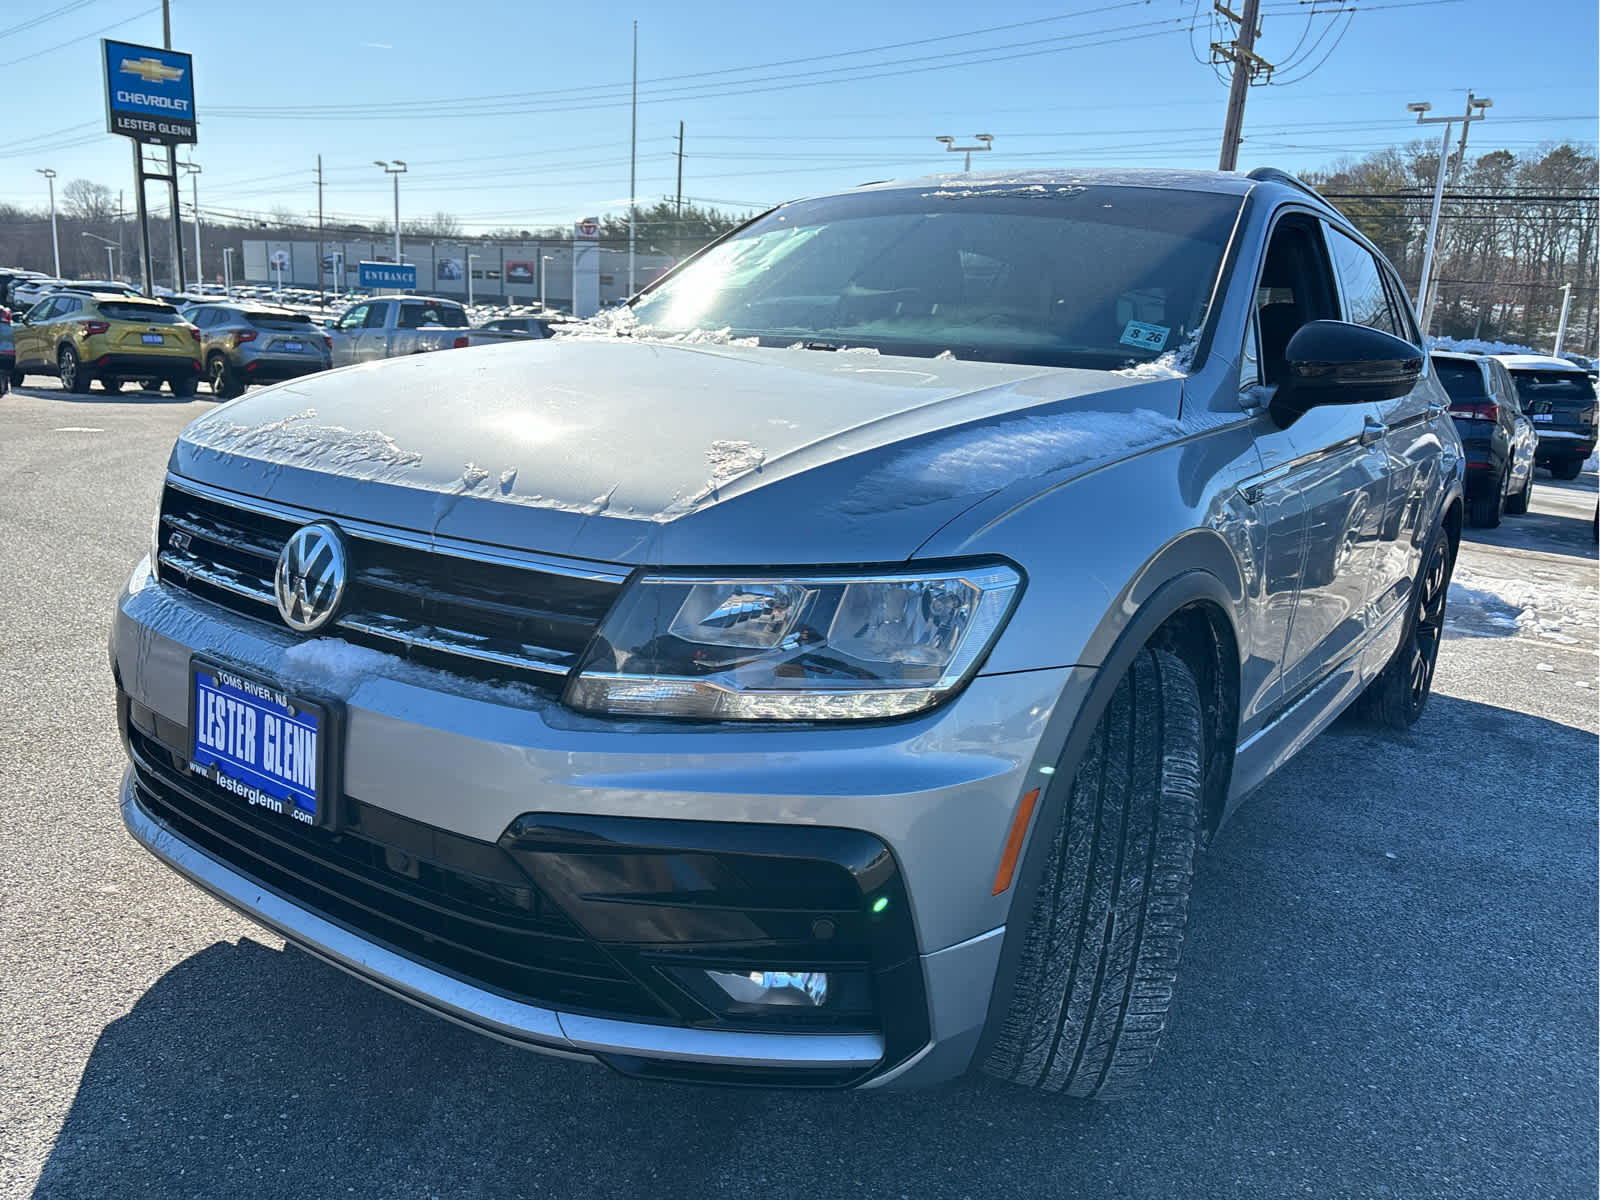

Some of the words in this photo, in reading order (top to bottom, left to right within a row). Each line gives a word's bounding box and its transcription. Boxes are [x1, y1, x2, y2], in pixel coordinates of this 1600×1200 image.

[117, 91, 188, 111] CHEVROLET
[118, 117, 156, 132] LESTER
[158, 123, 192, 136] GLENN
[365, 270, 414, 282] ENTRANCE
[1131, 329, 1141, 338] 8
[1145, 331, 1162, 343] 26
[217, 671, 243, 690] TOMS
[244, 681, 274, 702] RIVER,
[275, 693, 288, 708] NJ
[198, 688, 257, 765] LESTER
[263, 713, 318, 792] GLENN
